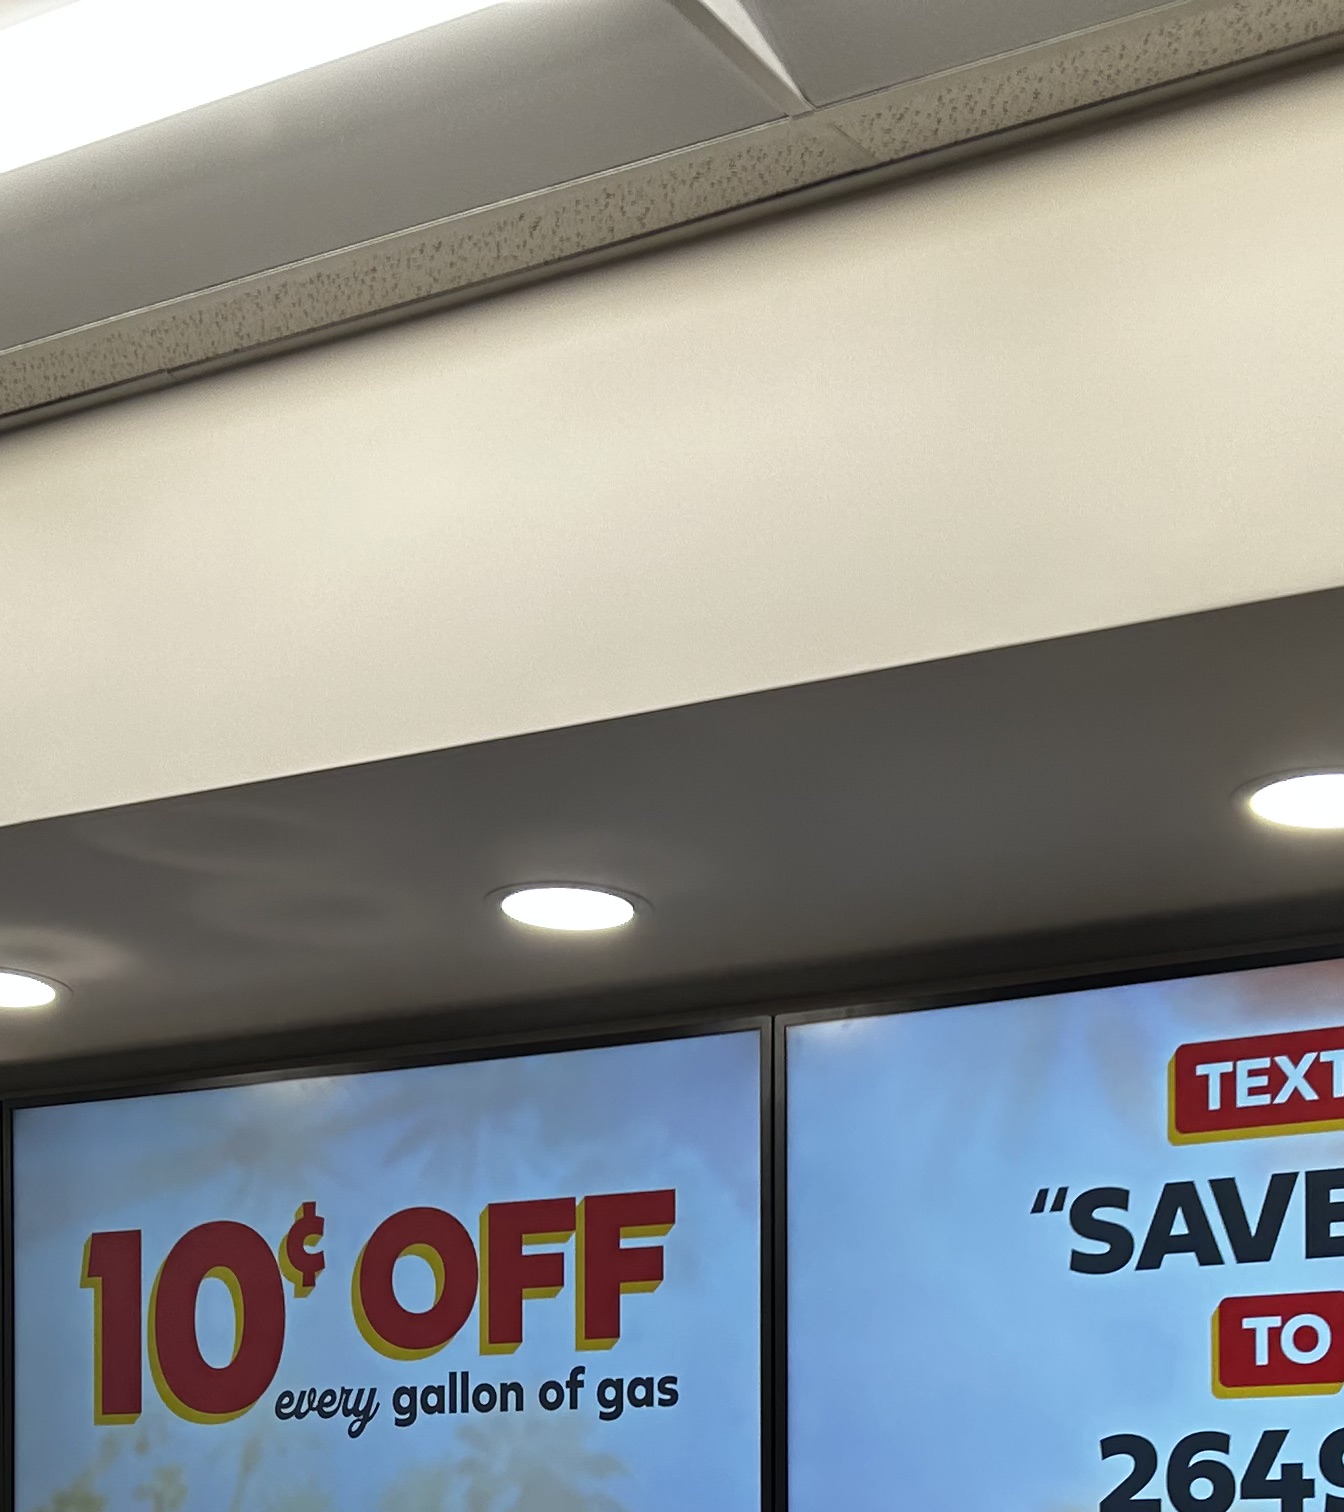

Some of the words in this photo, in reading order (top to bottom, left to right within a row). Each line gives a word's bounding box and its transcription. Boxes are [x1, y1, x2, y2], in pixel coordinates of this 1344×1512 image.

[351, 1189, 676, 1361] OFF
[1243, 1314, 1331, 1366] TO
[274, 1380, 379, 1439] every
[392, 1372, 524, 1427] gallon
[537, 1366, 586, 1411] of
[596, 1373, 679, 1421] gas
